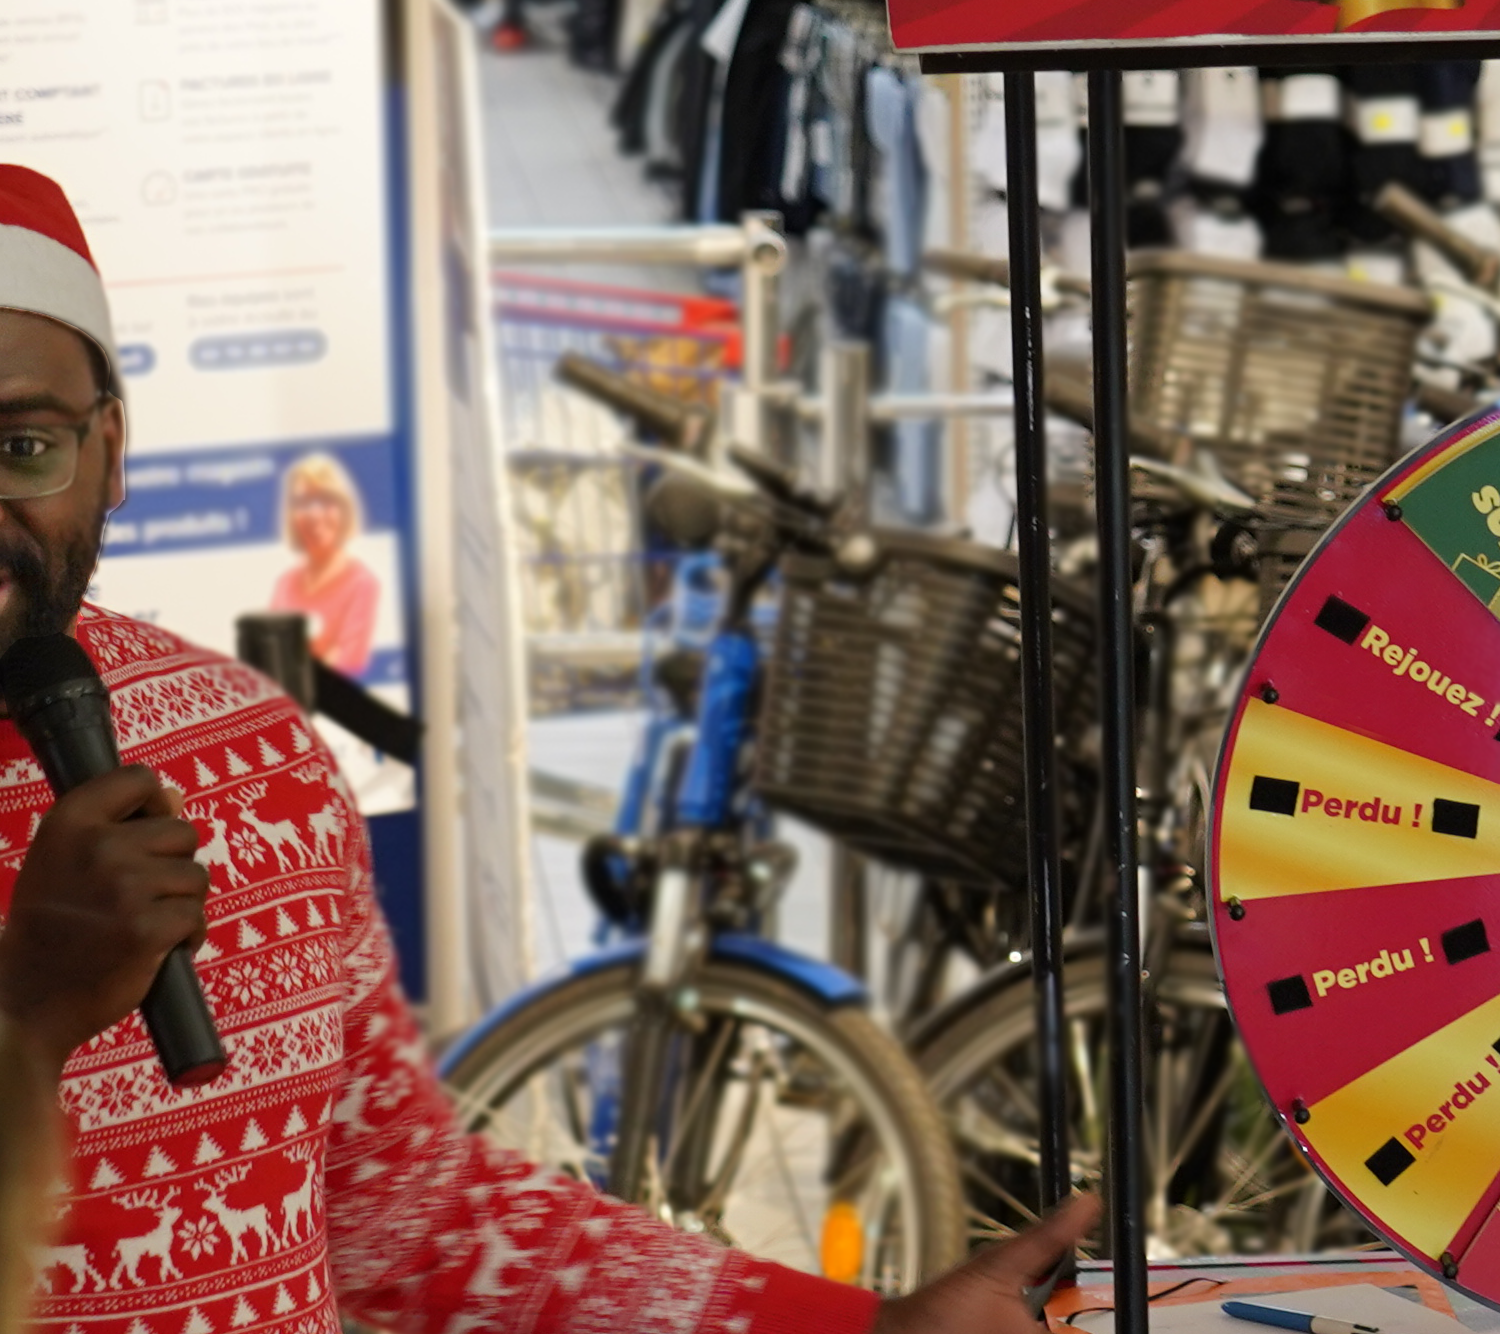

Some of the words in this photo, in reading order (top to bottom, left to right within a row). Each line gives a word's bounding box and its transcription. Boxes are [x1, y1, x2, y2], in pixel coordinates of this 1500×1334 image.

[1361, 626, 1488, 716] Rejouez
[1302, 789, 1402, 826] Perdu
[1312, 949, 1415, 997] Perdu
[1403, 1071, 1491, 1151] Perdu
